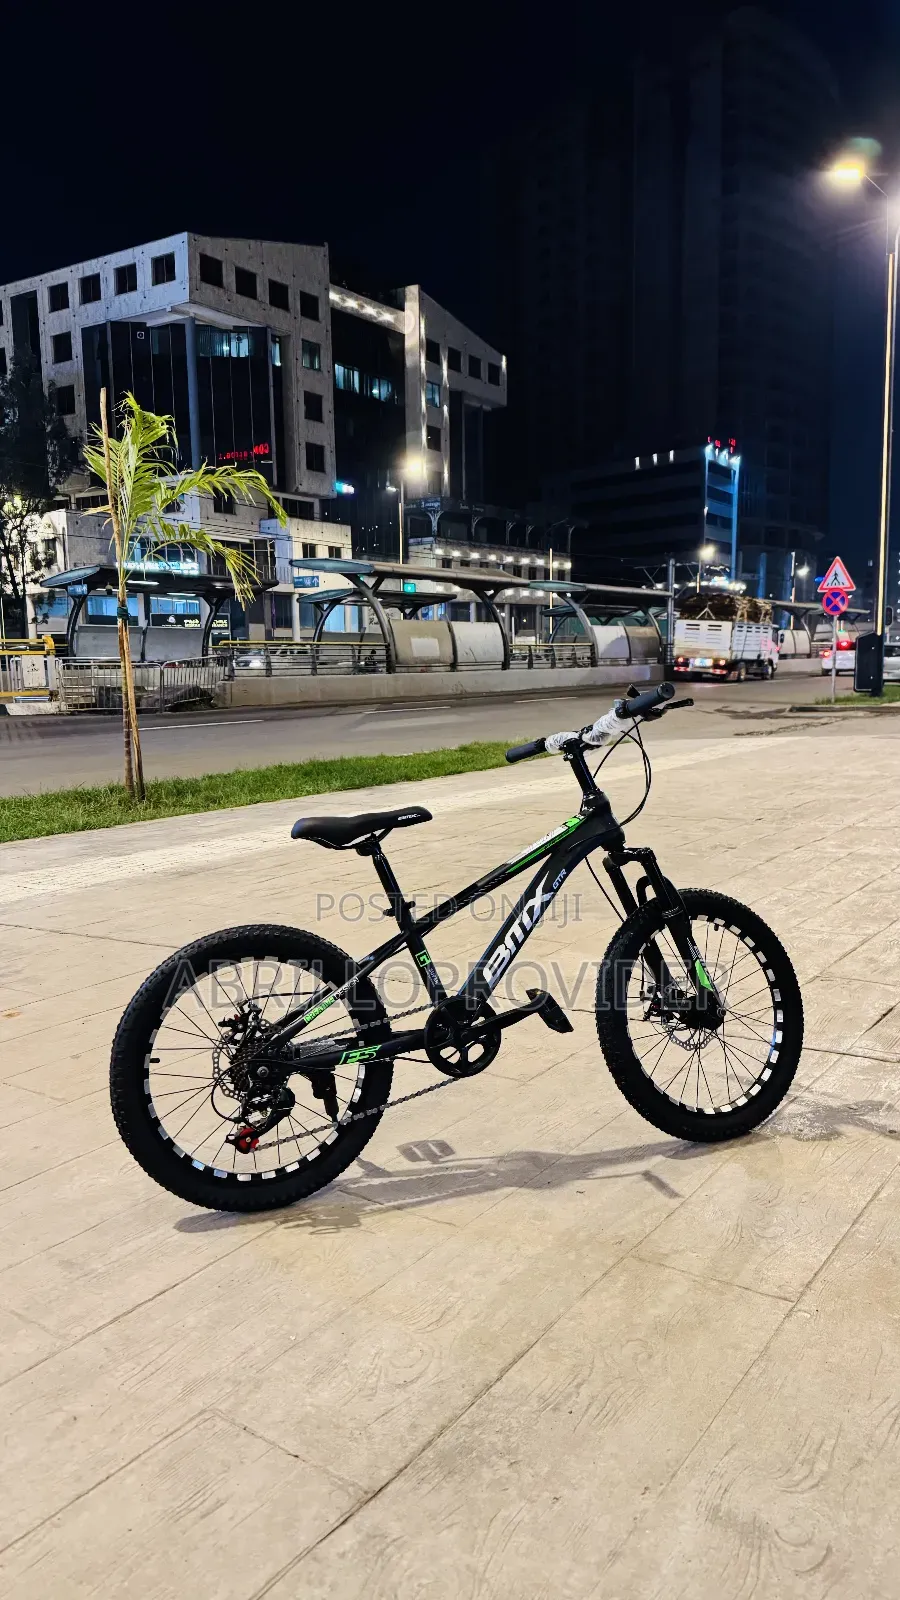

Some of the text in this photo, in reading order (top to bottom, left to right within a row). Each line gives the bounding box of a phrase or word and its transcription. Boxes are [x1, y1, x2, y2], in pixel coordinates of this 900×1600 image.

[552, 868, 567, 890] GTR
[483, 871, 554, 988] BMX
[333, 976, 360, 1000] DESIGN
